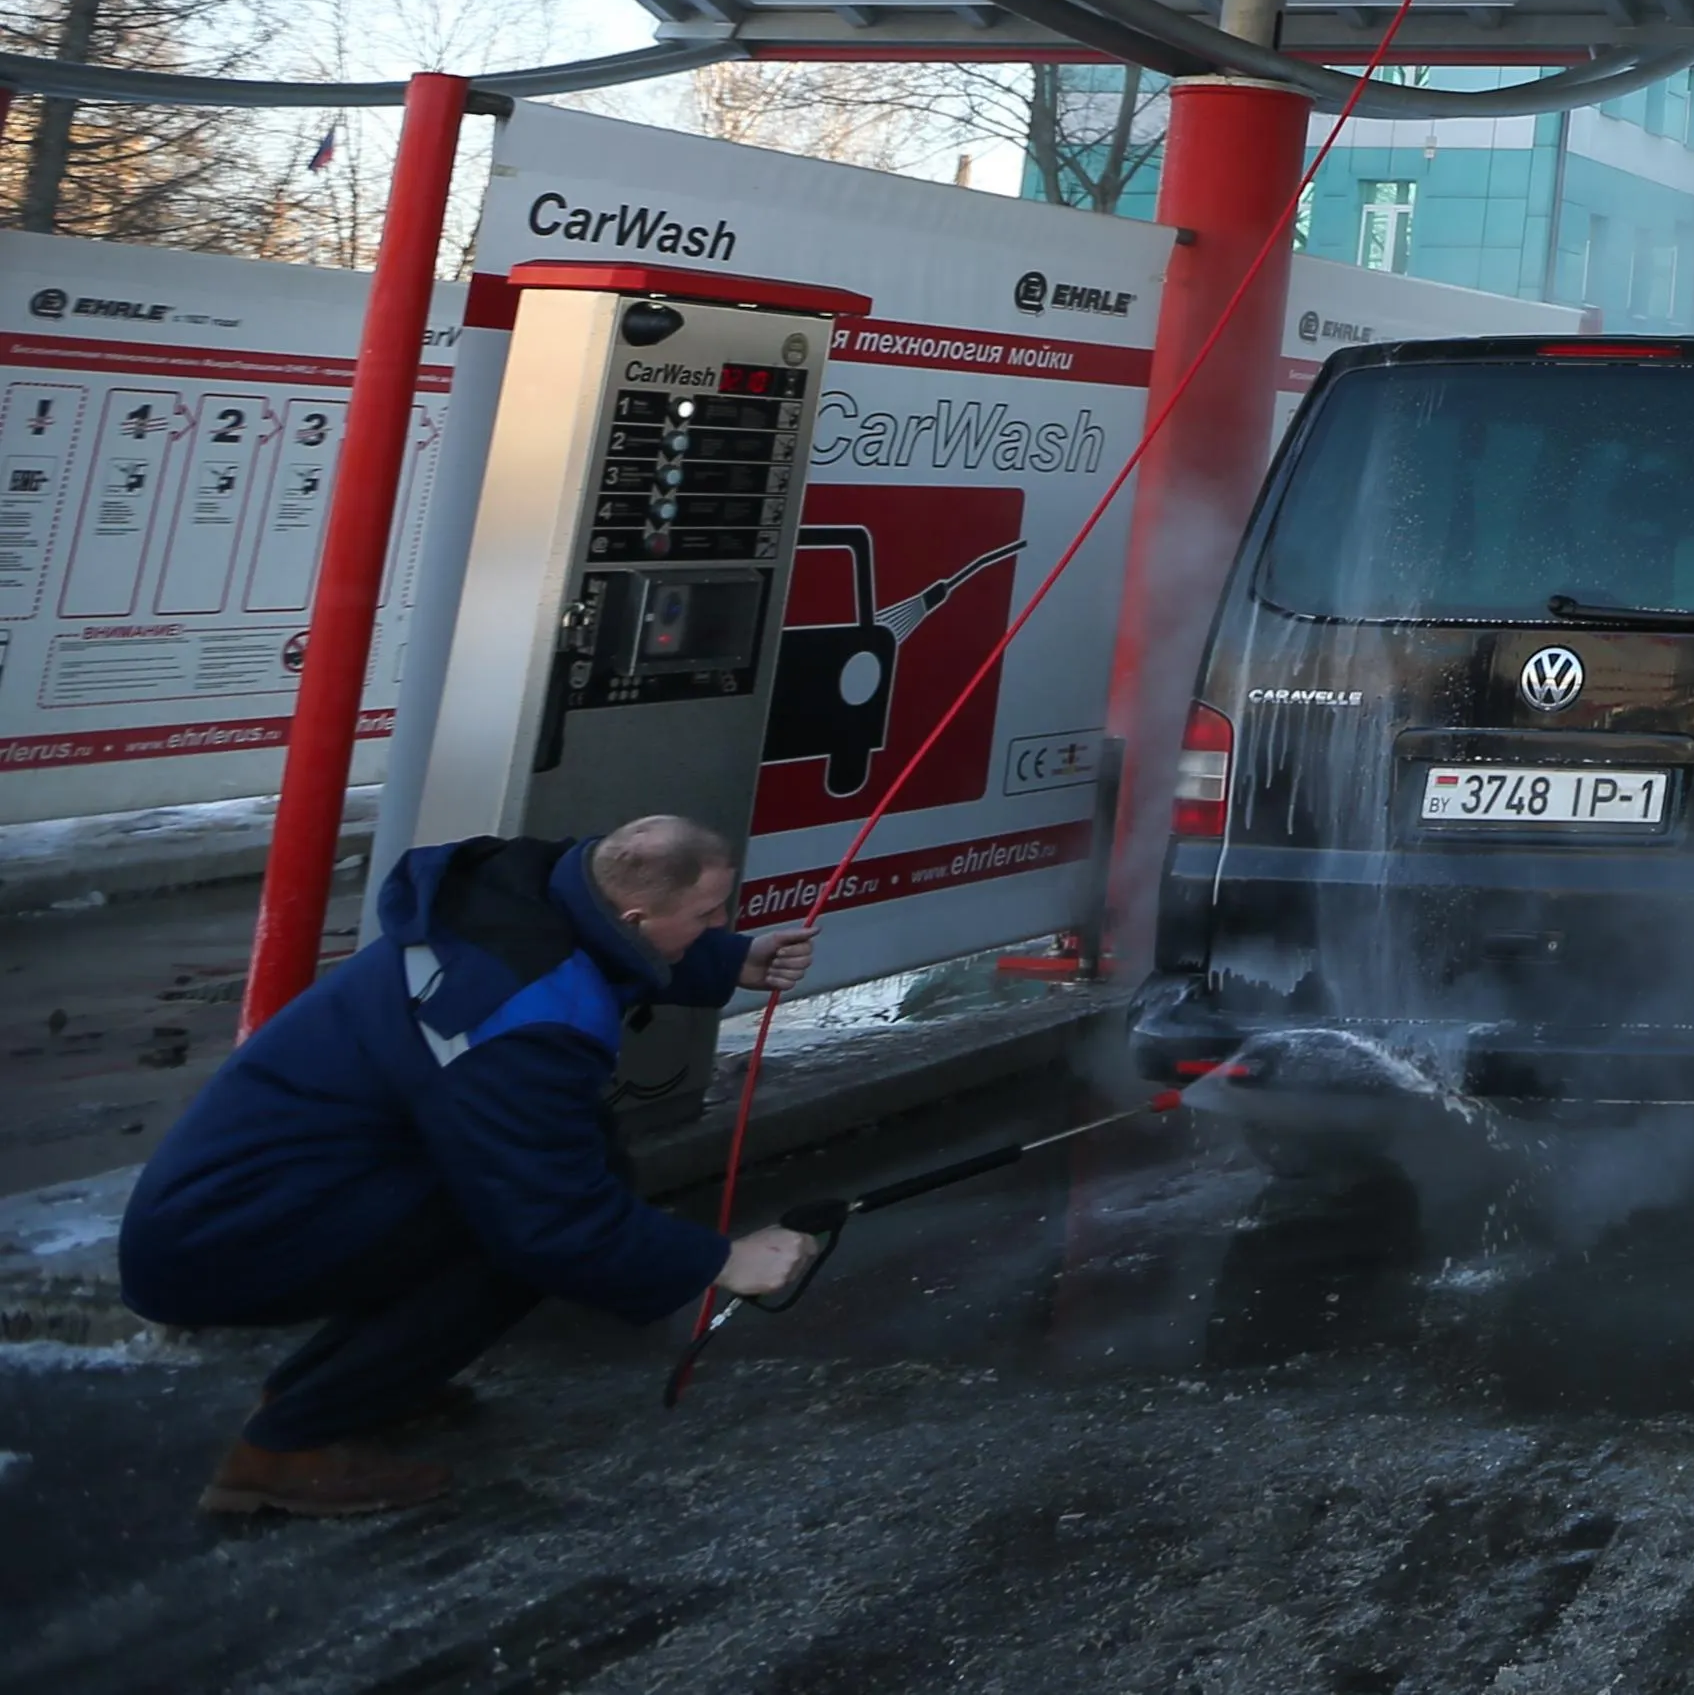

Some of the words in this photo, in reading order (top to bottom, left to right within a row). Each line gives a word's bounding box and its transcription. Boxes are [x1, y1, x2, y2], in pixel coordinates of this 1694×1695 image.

[529, 192, 736, 261] CarWash
[73, 297, 168, 322] EHRLE
[1052, 284, 1132, 315] EHRLE
[1321, 320, 1373, 343] EHRLE
[856, 332, 1004, 363] технология
[1008, 345, 1073, 370] мойки
[625, 361, 716, 387] CarWash
[619, 397, 630, 415] 1
[212, 409, 245, 443] 2
[298, 413, 328, 446] 3
[810, 390, 1105, 473] CarWash
[612, 432, 626, 450] 2
[606, 467, 619, 485] 3
[599, 502, 613, 520] 4
[1248, 689, 1363, 705] CARAVELLE
[1429, 797, 1450, 814] BY
[1461, 775, 1551, 816] 3748
[1571, 777, 1654, 819] IP-1
